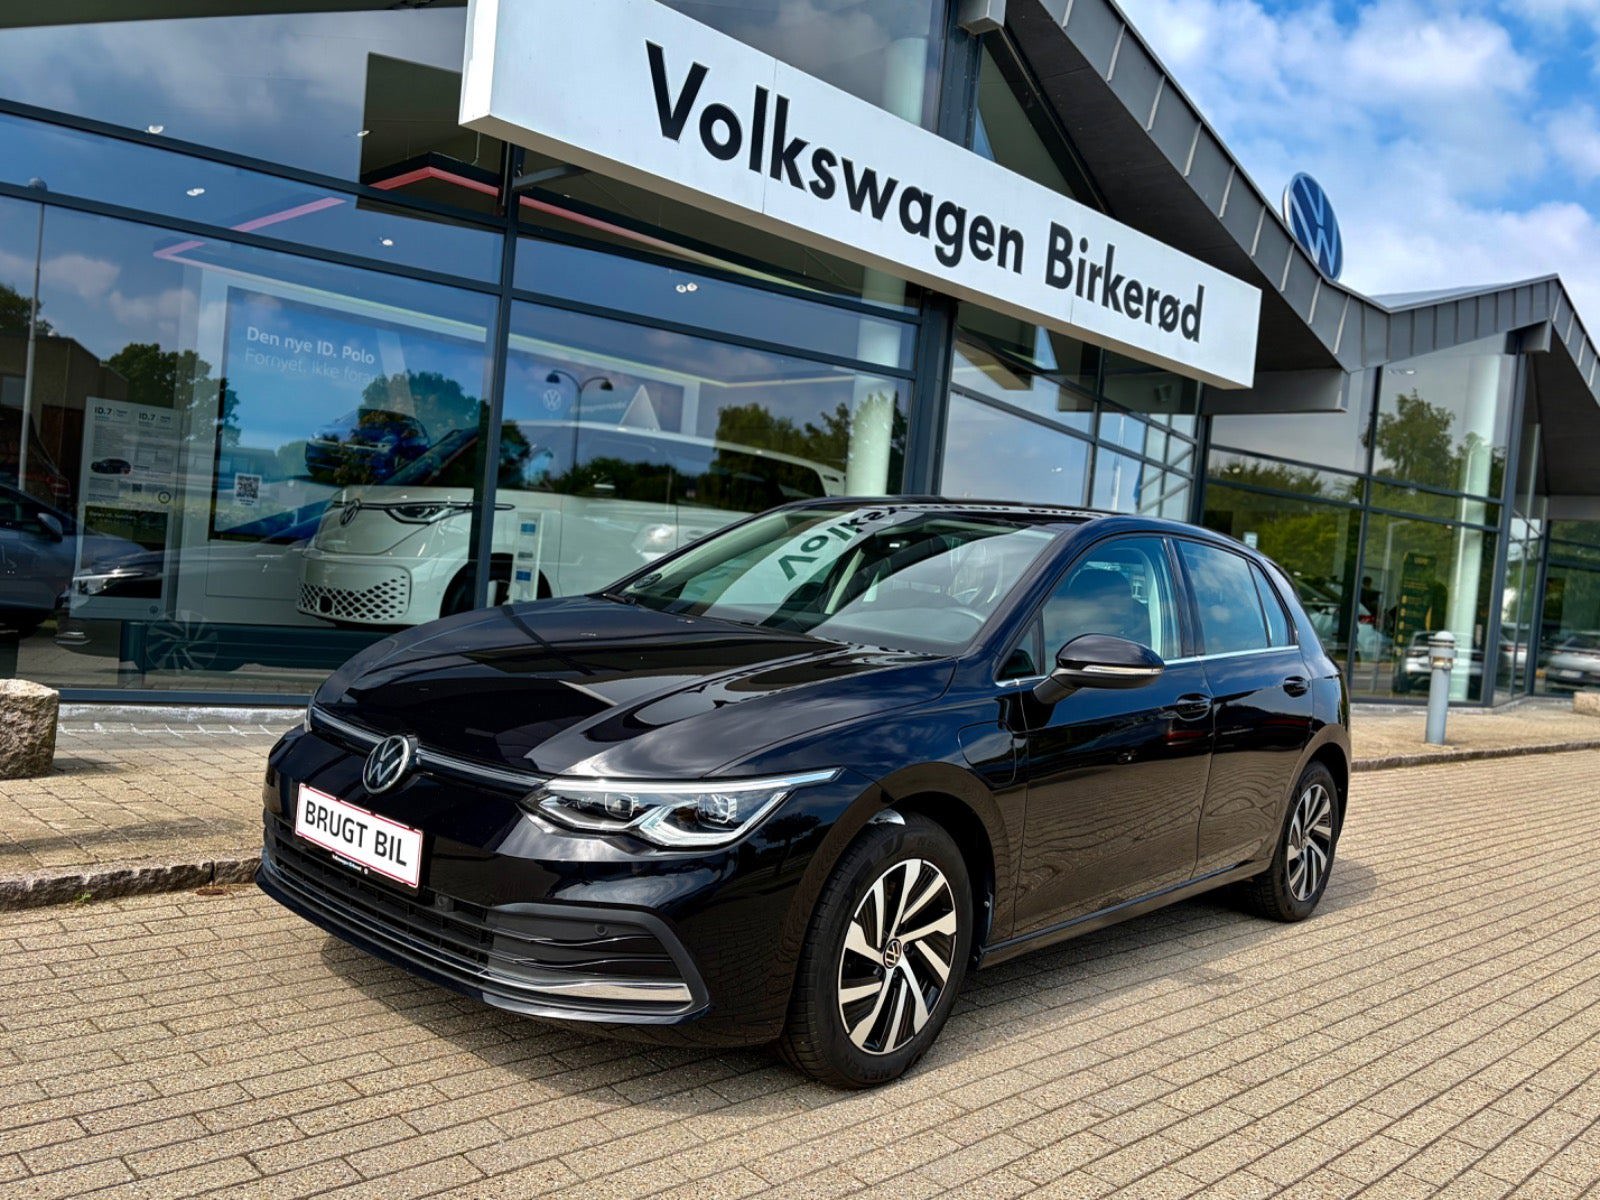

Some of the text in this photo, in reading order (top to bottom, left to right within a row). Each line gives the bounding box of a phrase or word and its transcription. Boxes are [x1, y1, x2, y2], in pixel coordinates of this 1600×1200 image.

[646, 39, 1204, 343] Volkswagen Birkerød
[247, 326, 375, 365] Den nye ID. Polo
[305, 799, 368, 848] BRUGT
[374, 830, 407, 867] BIL
